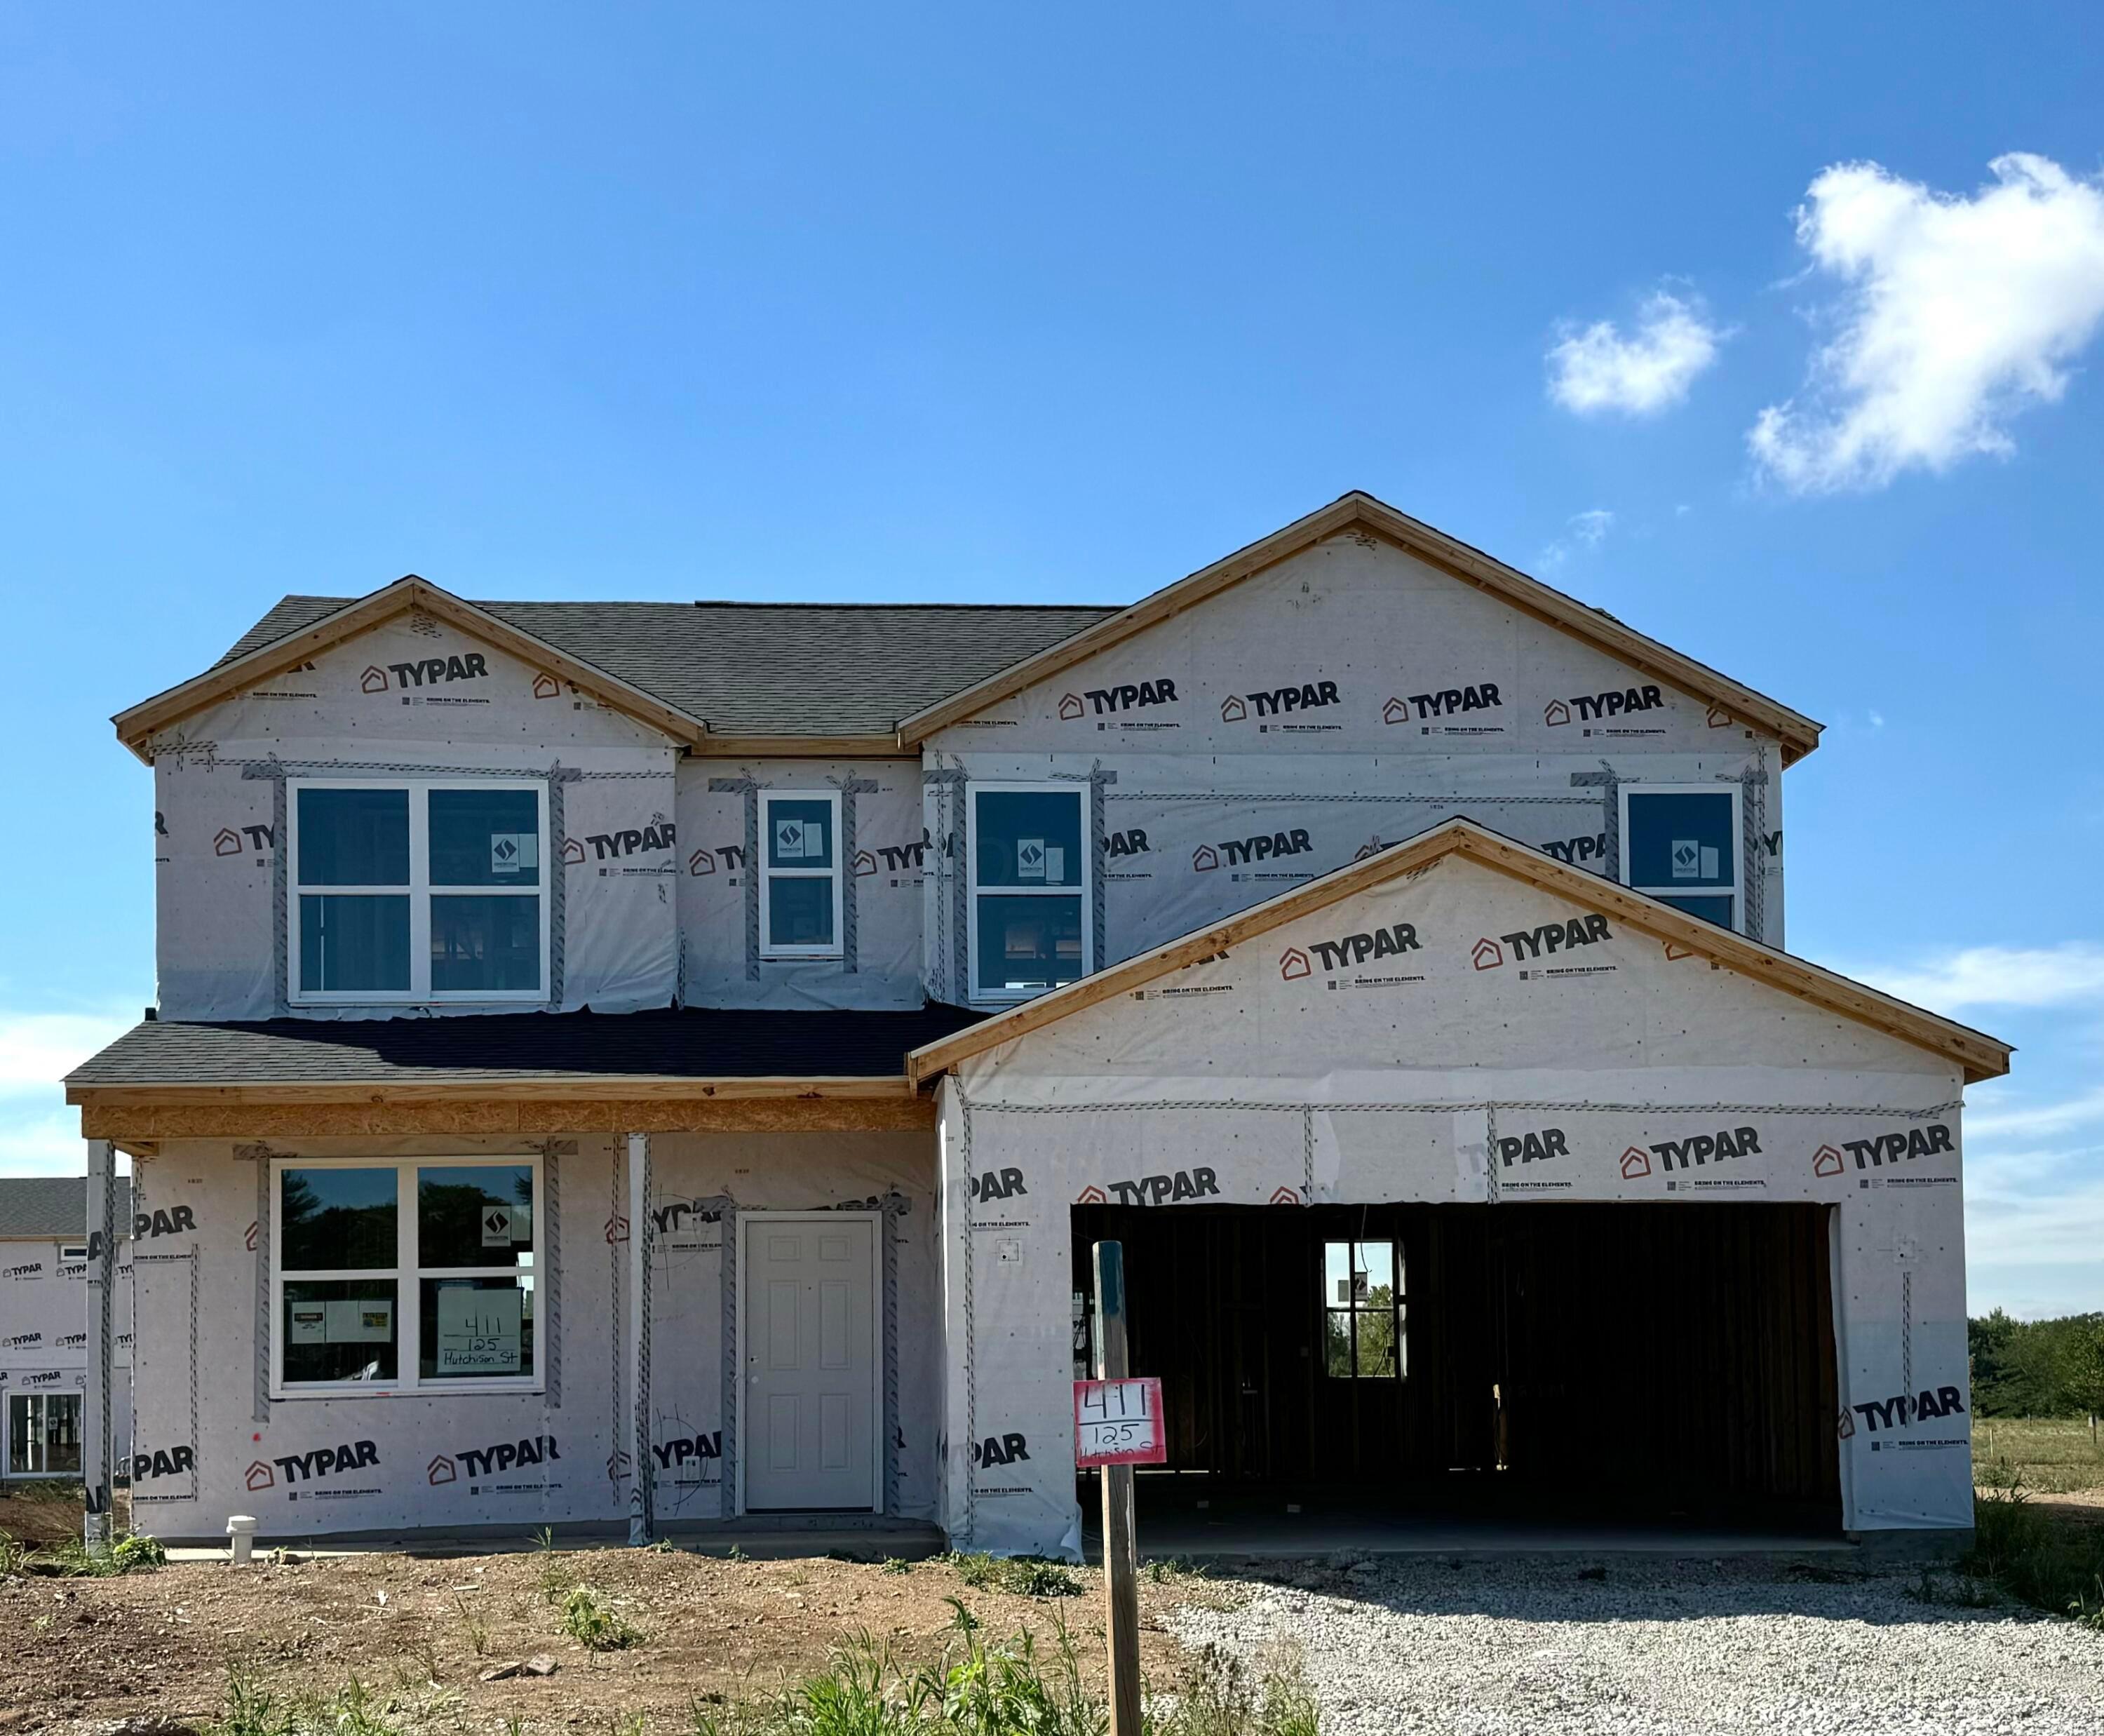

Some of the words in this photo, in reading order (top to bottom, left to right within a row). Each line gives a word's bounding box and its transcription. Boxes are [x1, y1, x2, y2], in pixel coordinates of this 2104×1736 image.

[387, 653, 489, 689] TYPAR
[1084, 678, 1179, 715] TYPAR
[1246, 680, 1341, 716] TYPAR
[1408, 683, 1502, 719] TYPAR
[1570, 685, 1664, 721] TYPAR
[585, 823, 675, 861] TYPAR
[1219, 828, 1314, 866] TYPAR
[1307, 923, 1421, 971] TYPAR
[1500, 914, 1613, 962] TYPAR
[1649, 1126, 1762, 1172] TYPAR
[1842, 1124, 1955, 1170] TYPAR
[1107, 1167, 1220, 1205] TYPAR
[465, 1307, 501, 1337] 411
[444, 1352, 494, 1365] Hutchison
[499, 1351, 518, 1364] St
[468, 1338, 500, 1351] 125
[1084, 1383, 1146, 1418] 411
[1852, 1386, 1965, 1432] TYPAR
[1095, 1423, 1140, 1444] 125
[273, 1440, 381, 1483] TYPAR
[455, 1435, 561, 1479] TYPAR
